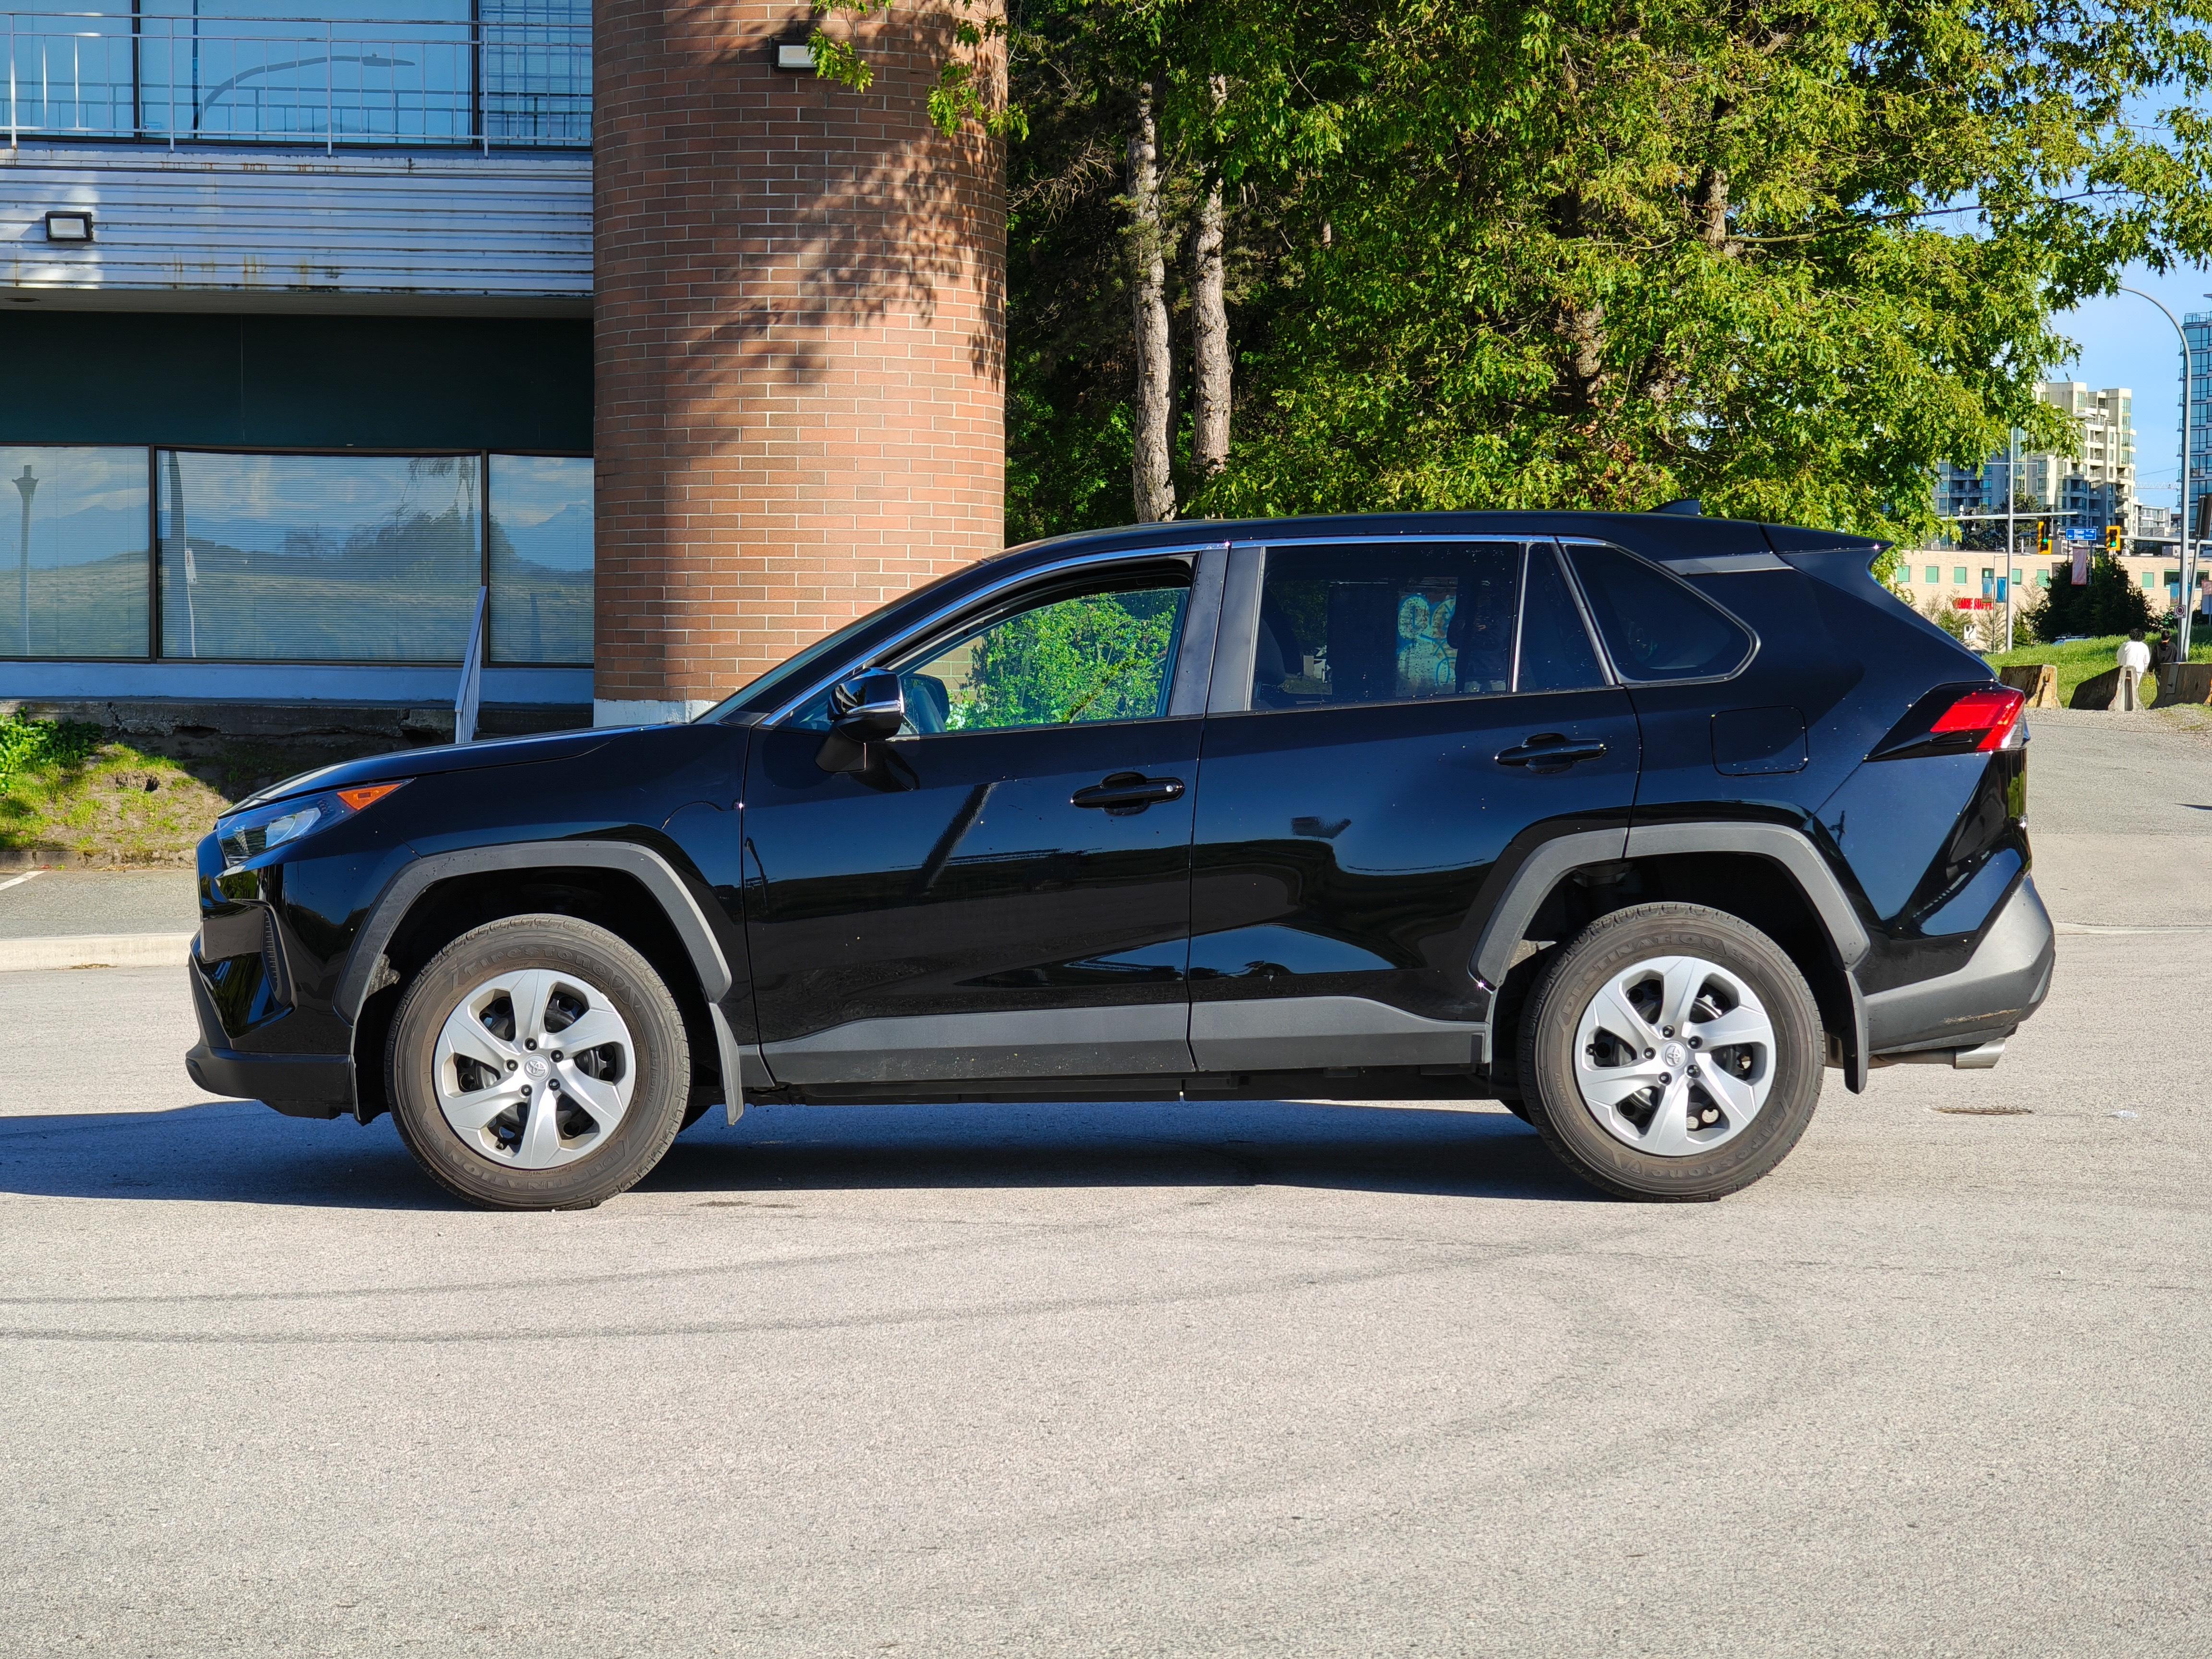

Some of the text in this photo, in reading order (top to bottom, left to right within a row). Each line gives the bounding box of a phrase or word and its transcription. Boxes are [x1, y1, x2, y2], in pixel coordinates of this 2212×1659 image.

[464, 946, 606, 977] Firestone
[1562, 934, 1720, 1015] DESTINATION
[1554, 1072, 1579, 1126] 225/65R17
